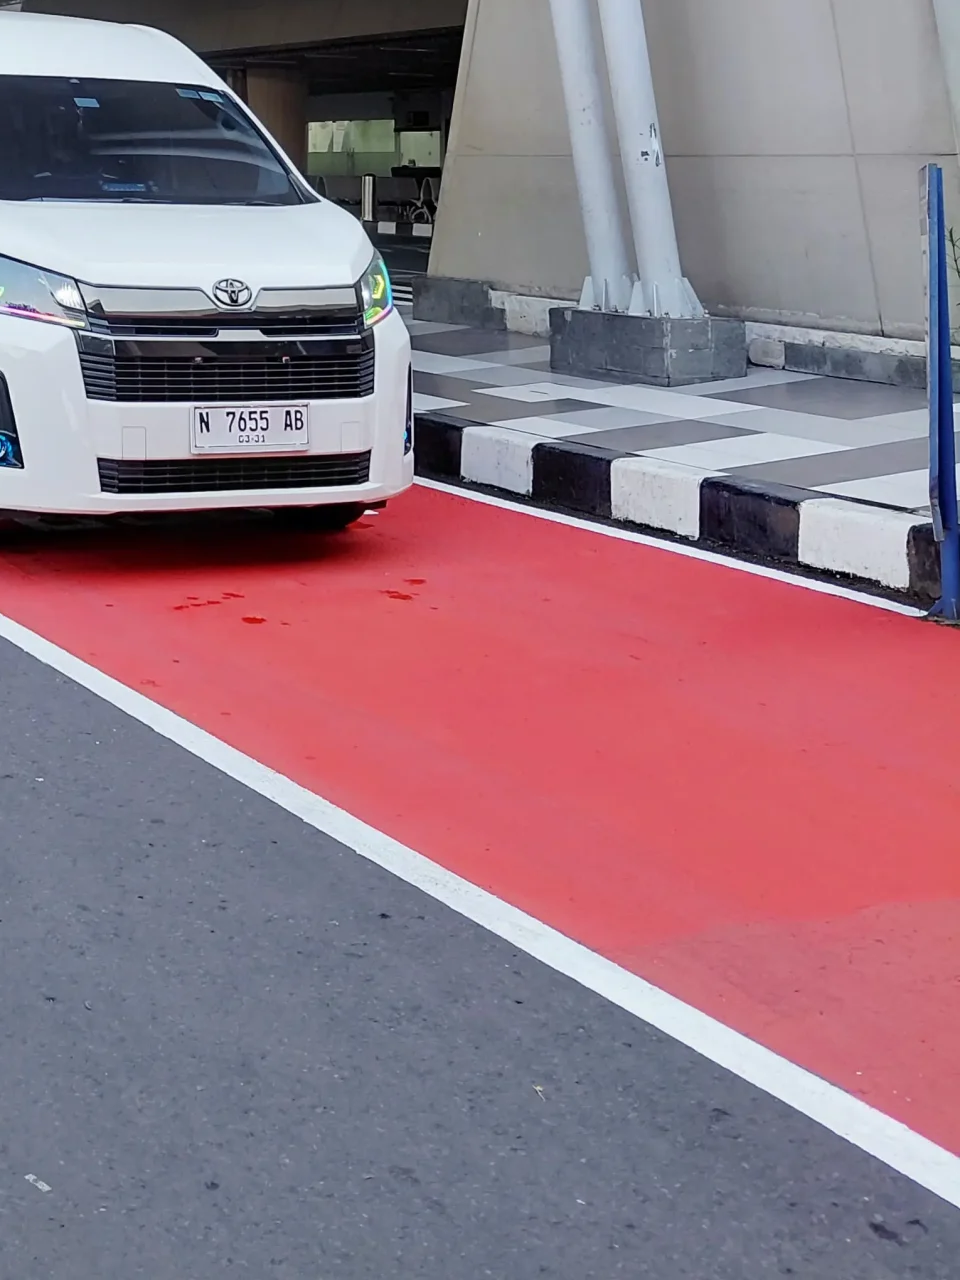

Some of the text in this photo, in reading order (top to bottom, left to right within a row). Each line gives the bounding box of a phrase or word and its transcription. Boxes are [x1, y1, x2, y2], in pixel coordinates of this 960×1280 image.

[199, 410, 304, 433] N 7655 AB
